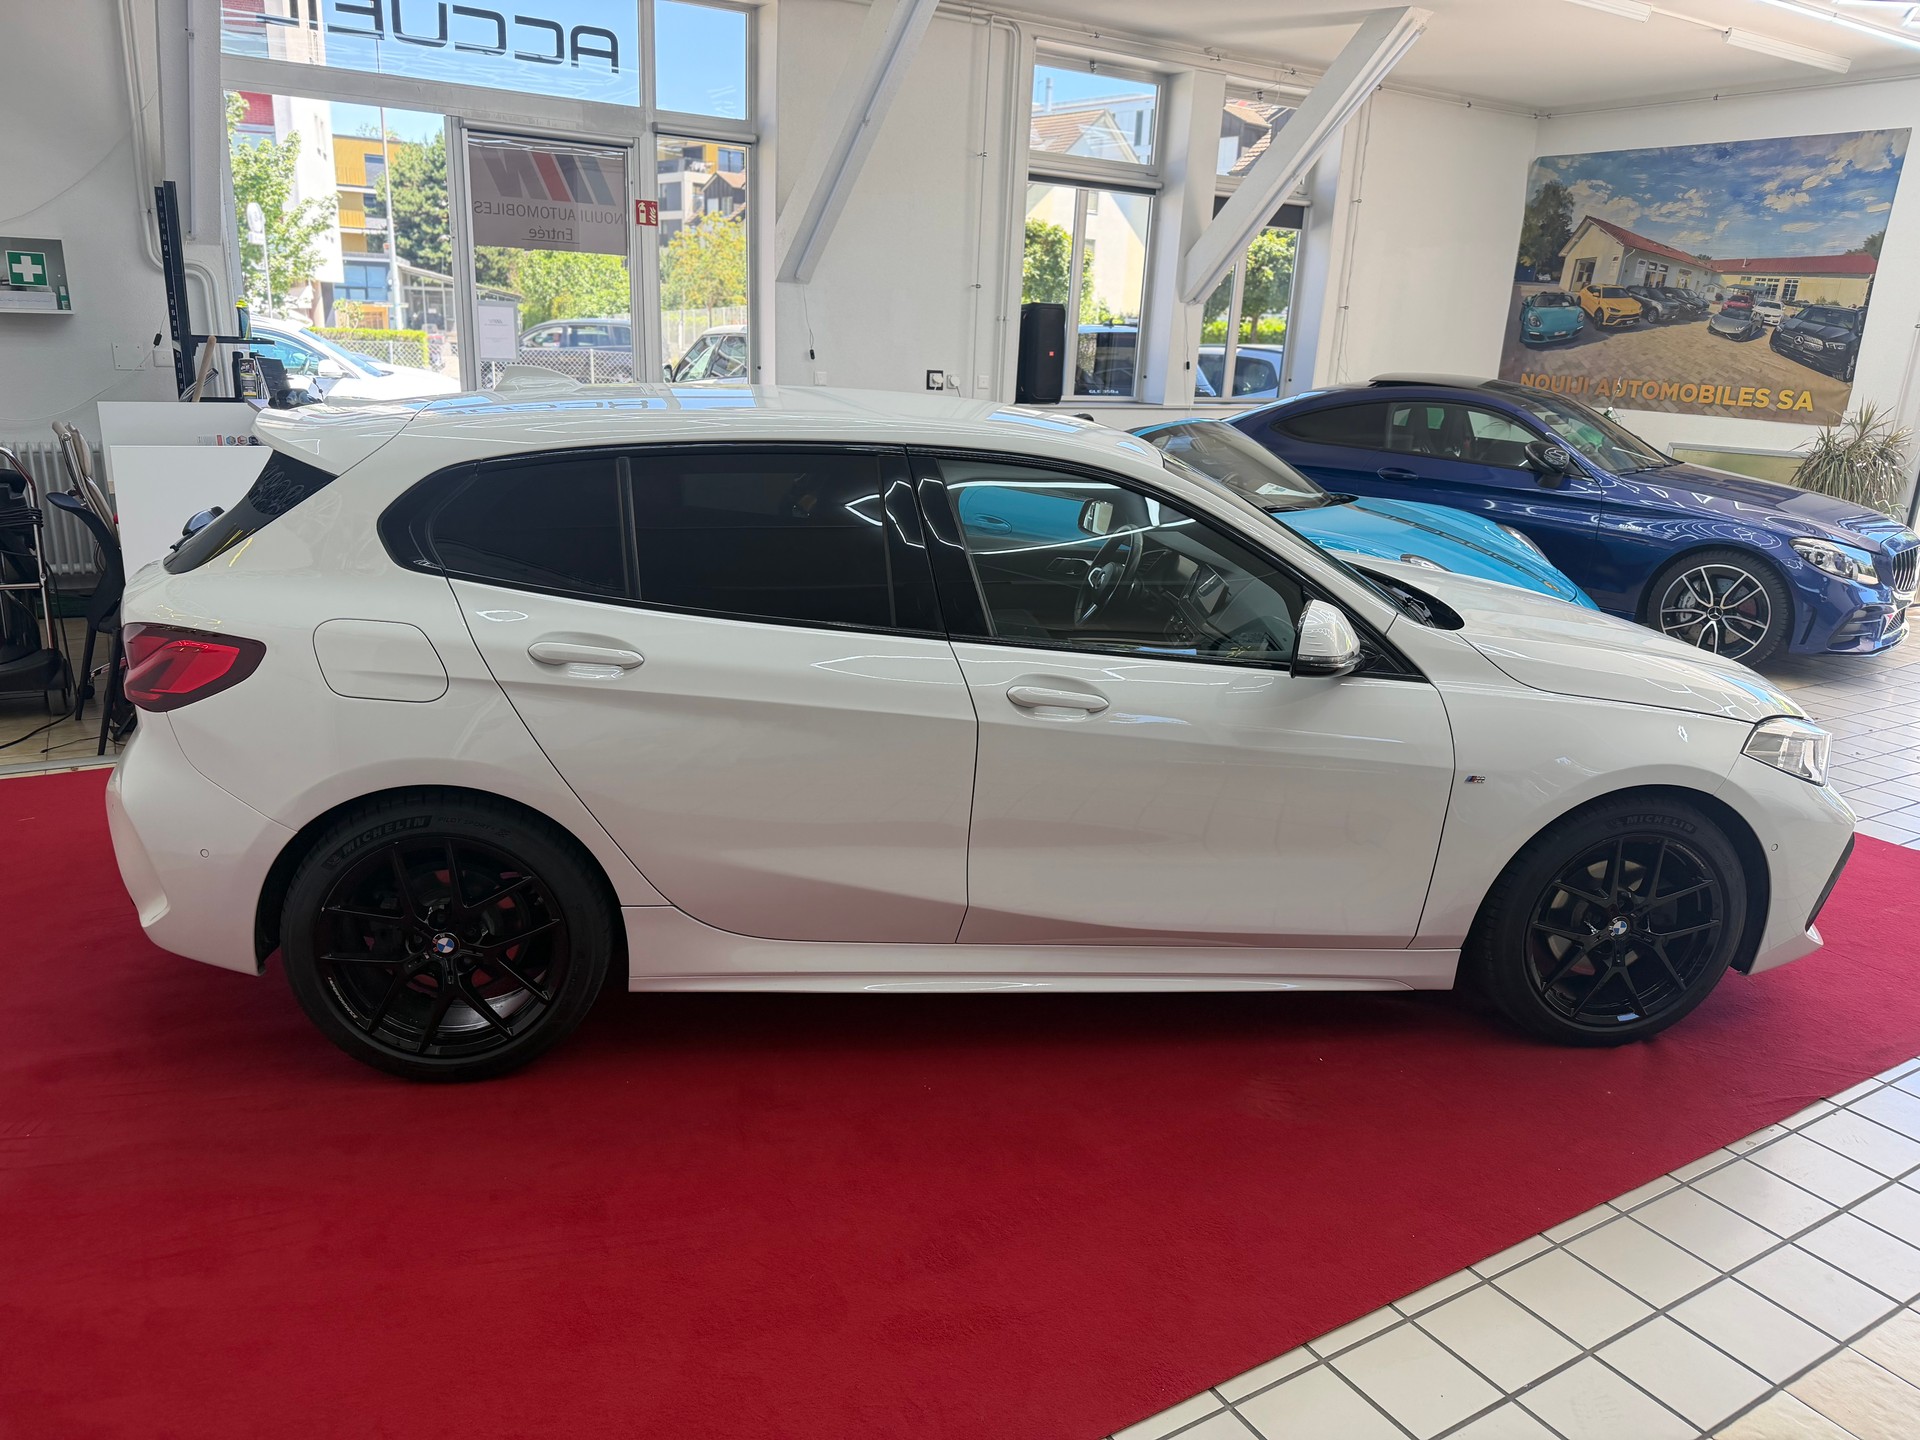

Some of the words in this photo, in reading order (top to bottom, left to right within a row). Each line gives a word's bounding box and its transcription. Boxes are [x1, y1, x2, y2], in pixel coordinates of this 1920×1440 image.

[1520, 372, 1590, 395] NOUIJI
[1594, 377, 1771, 408] AUTOMOBILES
[1776, 388, 1814, 412] SA
[342, 817, 427, 855] MICHELIN
[1626, 814, 1695, 833] MICHELIN
